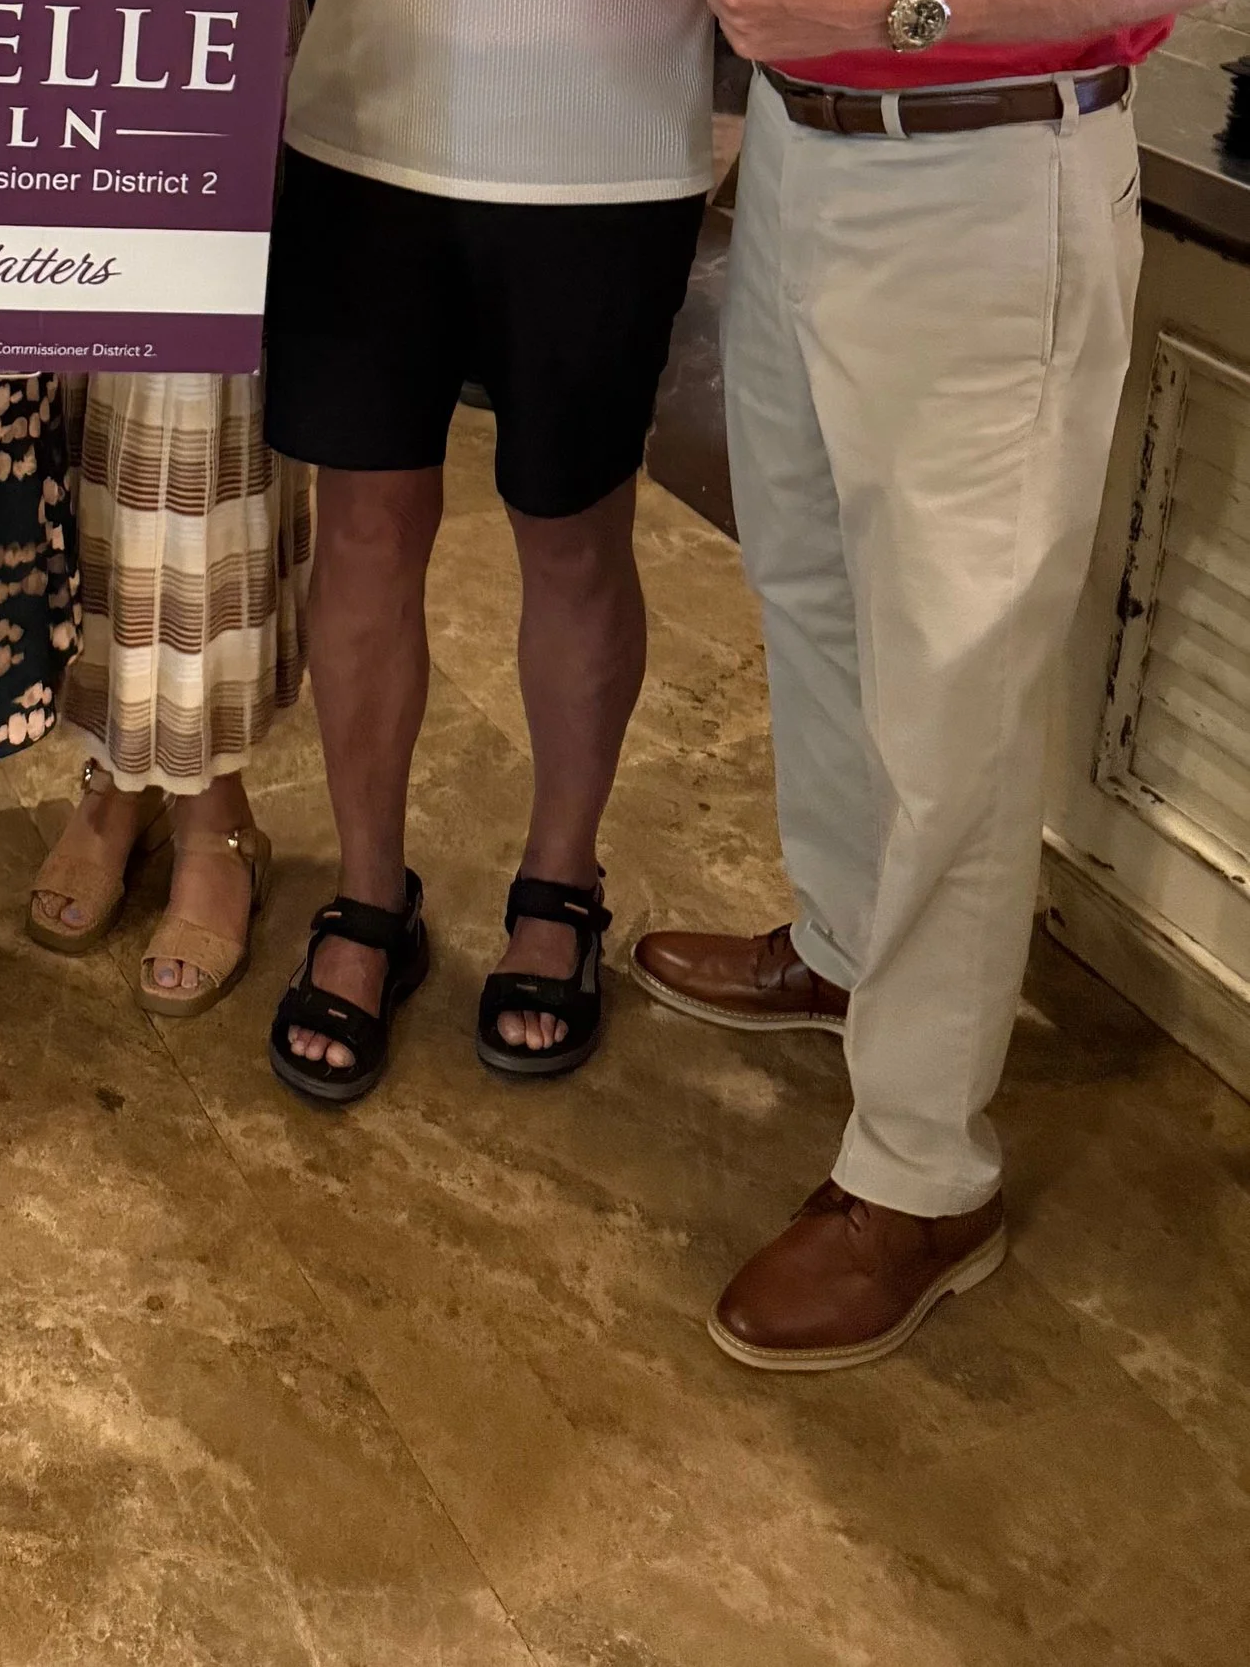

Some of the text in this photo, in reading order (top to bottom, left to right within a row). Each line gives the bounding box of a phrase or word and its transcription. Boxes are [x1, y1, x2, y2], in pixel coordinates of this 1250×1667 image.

[92, 168, 189, 195] District
[201, 171, 218, 195] 2
[92, 343, 140, 357] District
